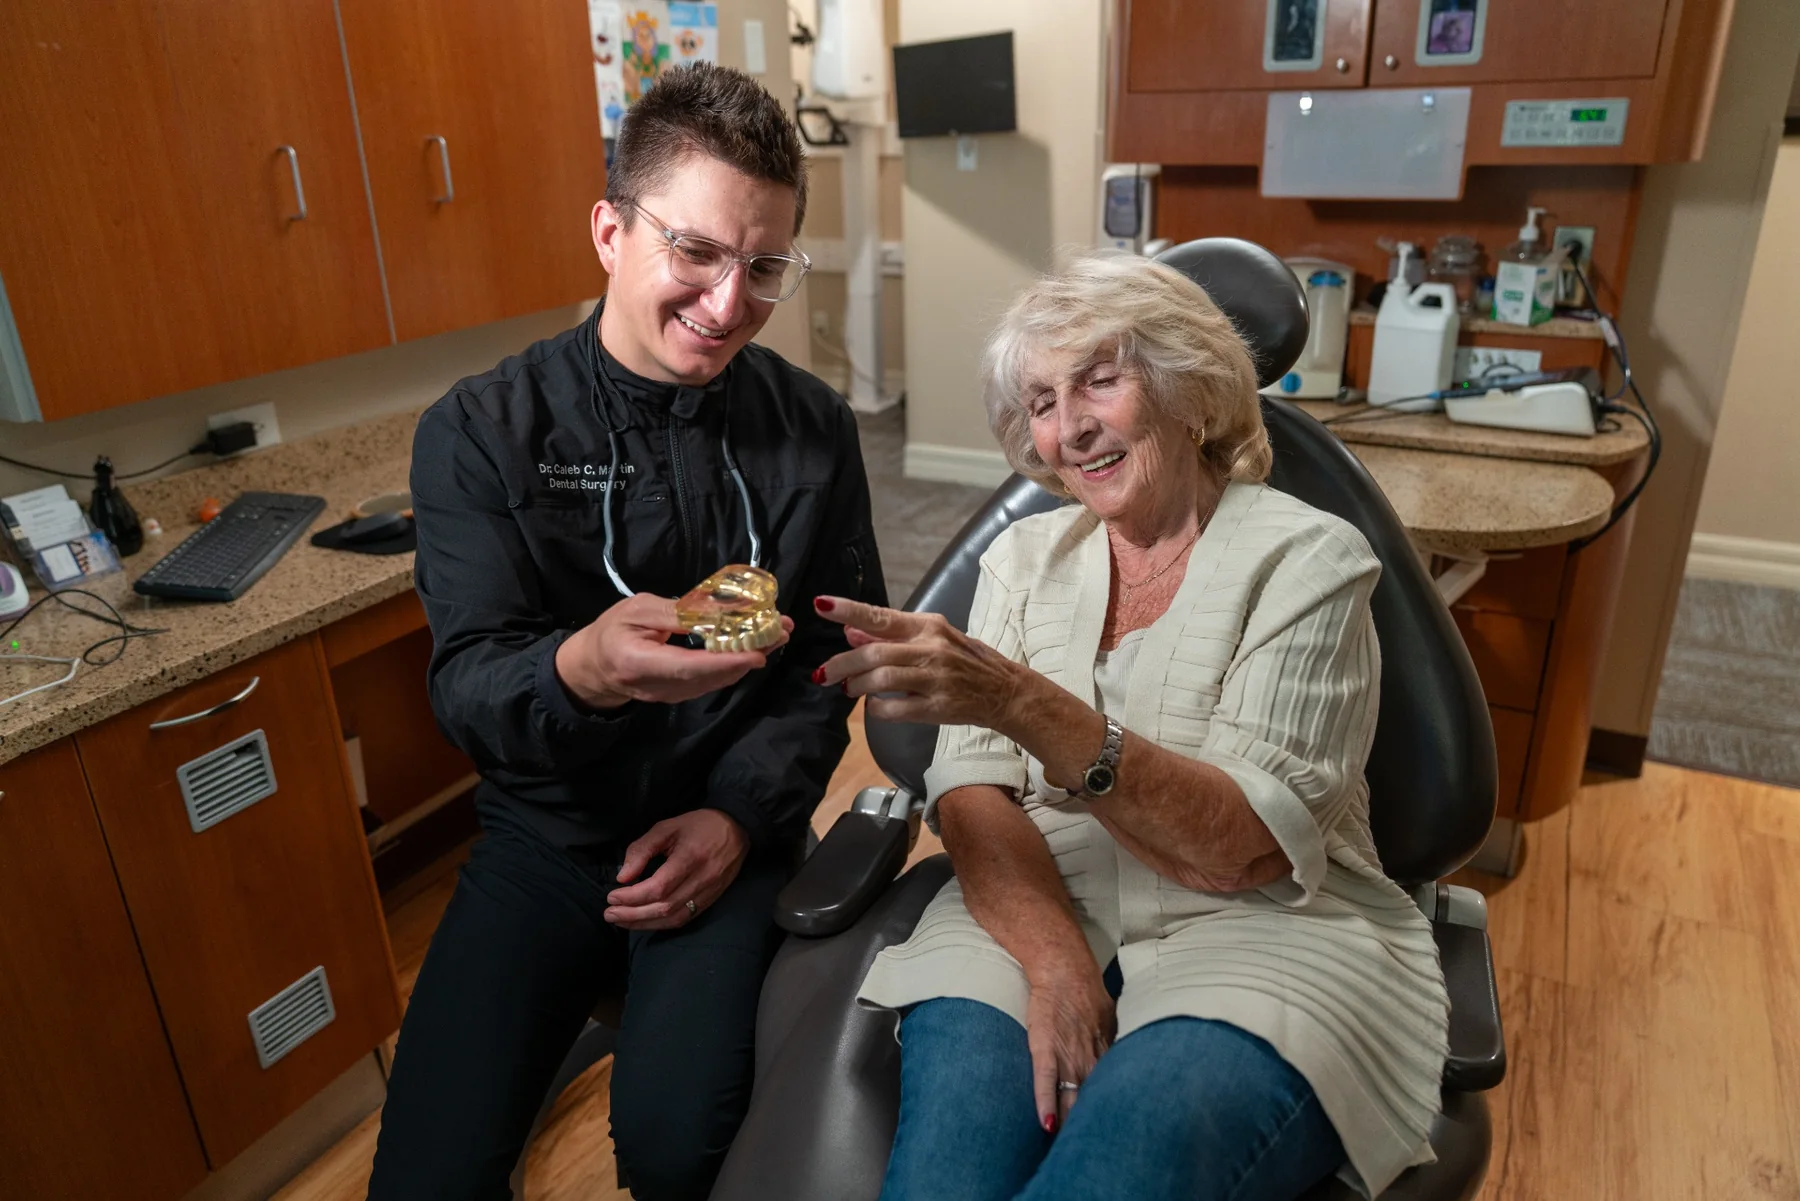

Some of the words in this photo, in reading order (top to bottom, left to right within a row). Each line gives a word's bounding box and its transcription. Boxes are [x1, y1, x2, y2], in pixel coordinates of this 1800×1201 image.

[538, 463, 553, 474] Dr.
[553, 464, 581, 475] Caleb
[583, 464, 596, 475] C.
[598, 463, 635, 475] Mtin
[549, 477, 579, 489] Dental
[580, 479, 626, 491] Surgry
